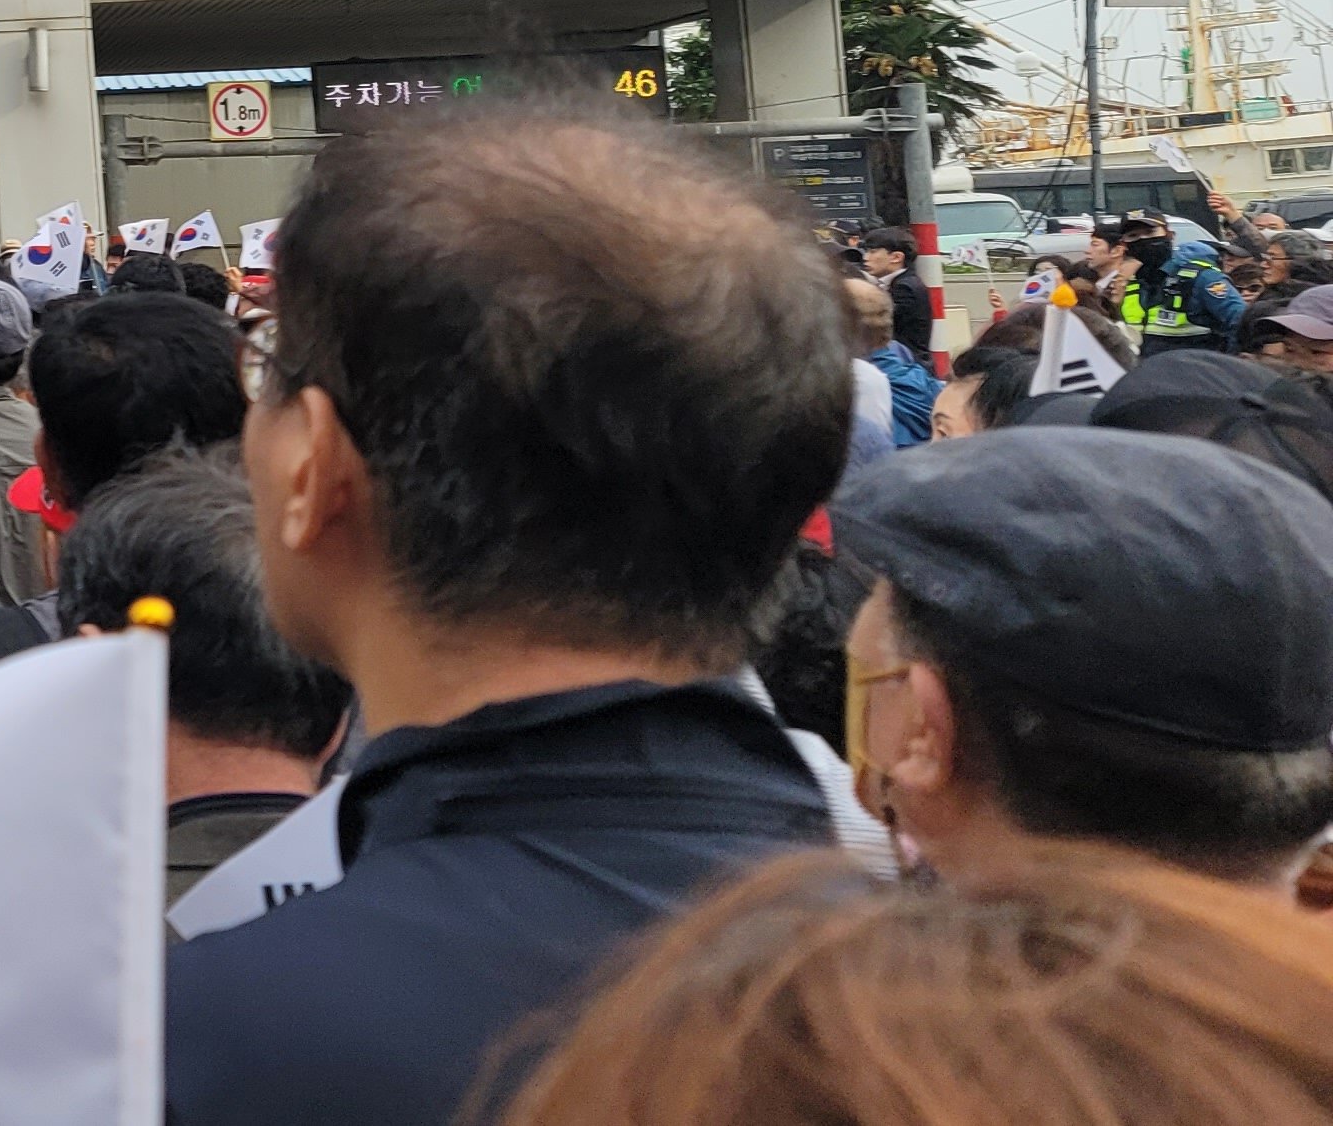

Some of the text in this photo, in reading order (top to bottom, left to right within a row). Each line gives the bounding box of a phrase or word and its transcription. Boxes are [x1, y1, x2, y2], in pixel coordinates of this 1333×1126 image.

[324, 80, 444, 108] 주차가능
[613, 69, 658, 99] 46
[219, 98, 262, 122] 1.8m
